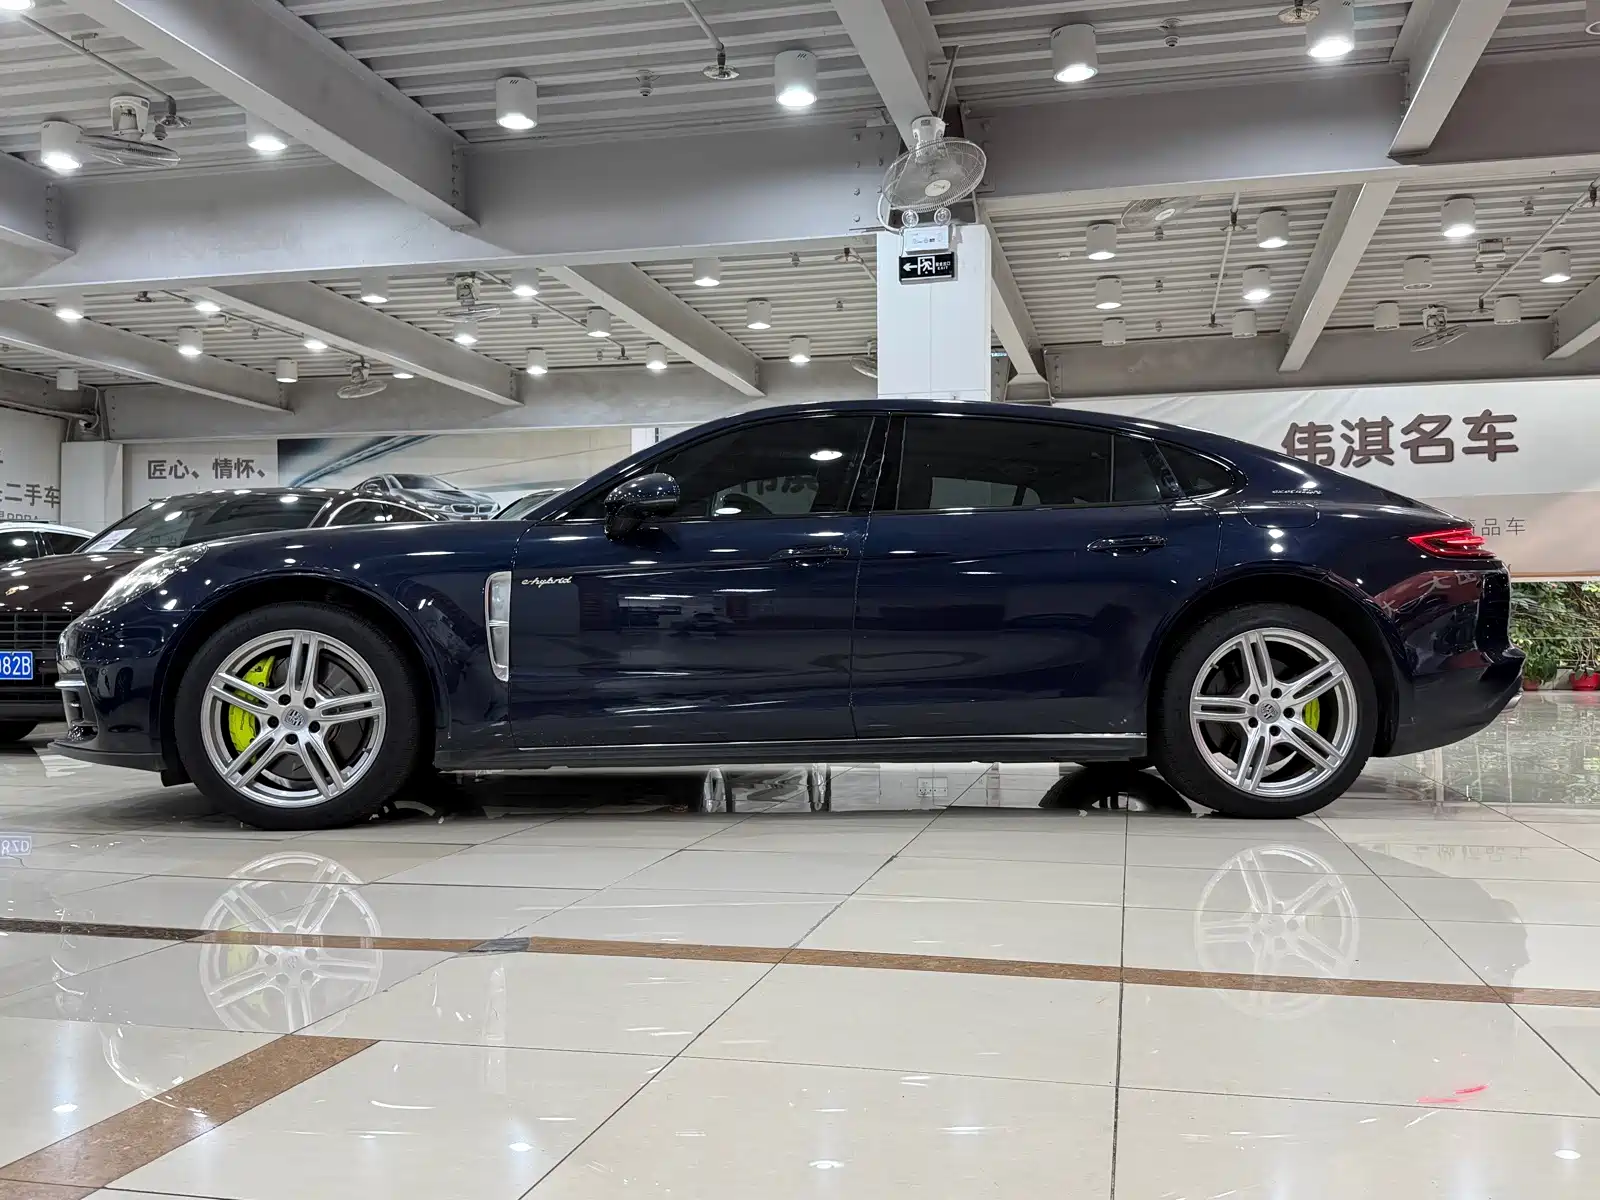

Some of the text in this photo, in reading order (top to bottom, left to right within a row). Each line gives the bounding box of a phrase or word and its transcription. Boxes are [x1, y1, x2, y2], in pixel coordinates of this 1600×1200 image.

[1281, 409, 1519, 468] 伟淇名车
[0, 483, 60, 509] 二手车
[521, 575, 573, 588] e-hybrid
[0, 656, 31, 676] 82B
